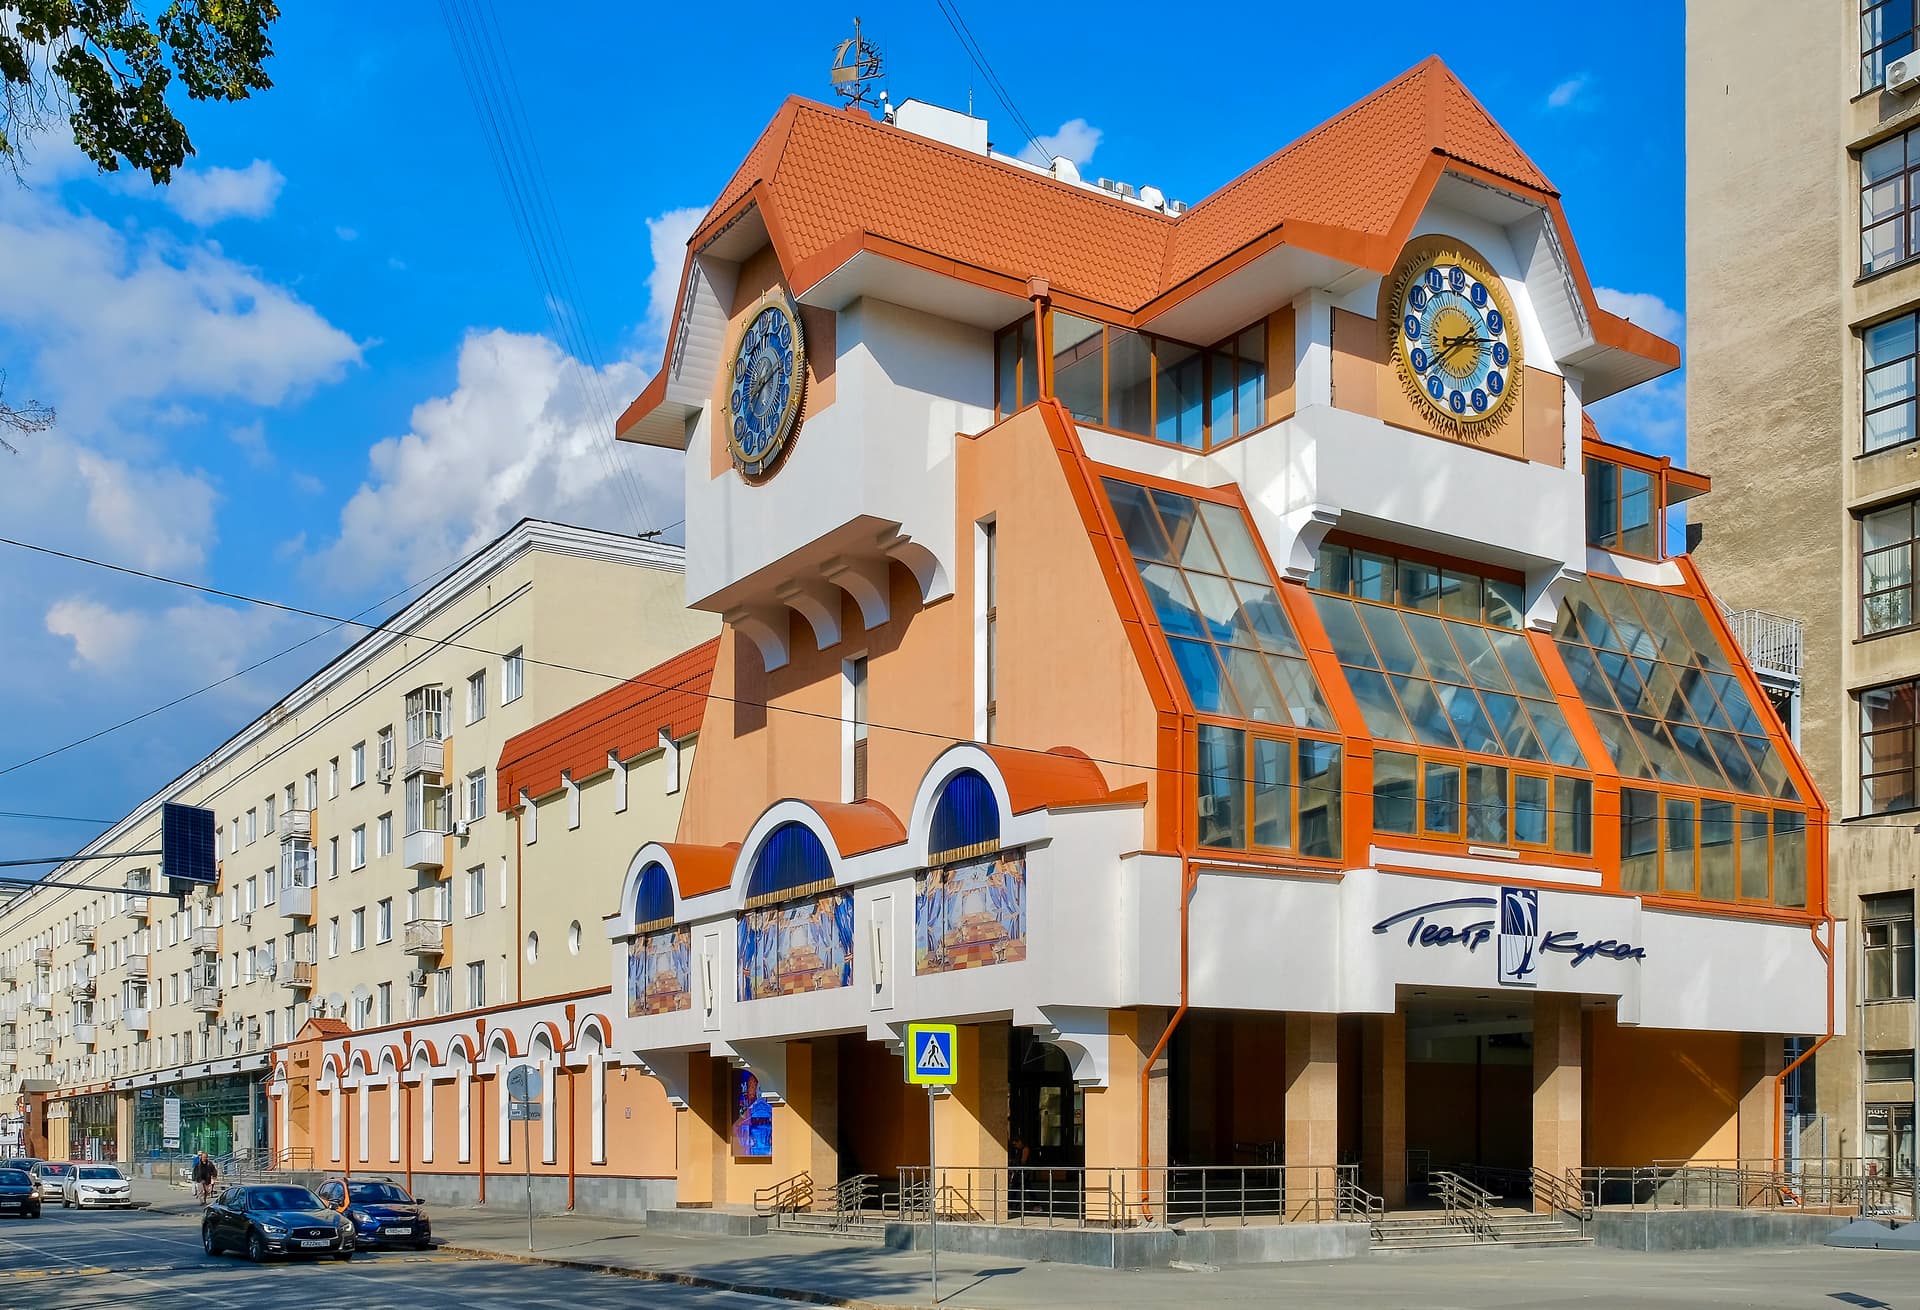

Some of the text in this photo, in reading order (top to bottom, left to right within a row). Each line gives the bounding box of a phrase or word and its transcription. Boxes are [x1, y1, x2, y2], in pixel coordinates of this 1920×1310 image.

[1429, 272, 1440, 288] 11
[1451, 271, 1463, 288] 12
[1412, 290, 1425, 305] 10
[1476, 287, 1482, 301] 1
[1408, 319, 1416, 334] 9
[1491, 315, 1499, 330] 2
[1415, 352, 1423, 370] 8
[1497, 345, 1505, 363] 3
[1431, 380, 1439, 394] 7
[1491, 376, 1498, 390] 4
[1454, 395, 1461, 410] 6
[1476, 393, 1483, 408] 5
[1372, 897, 1646, 967] Театр Кукол
